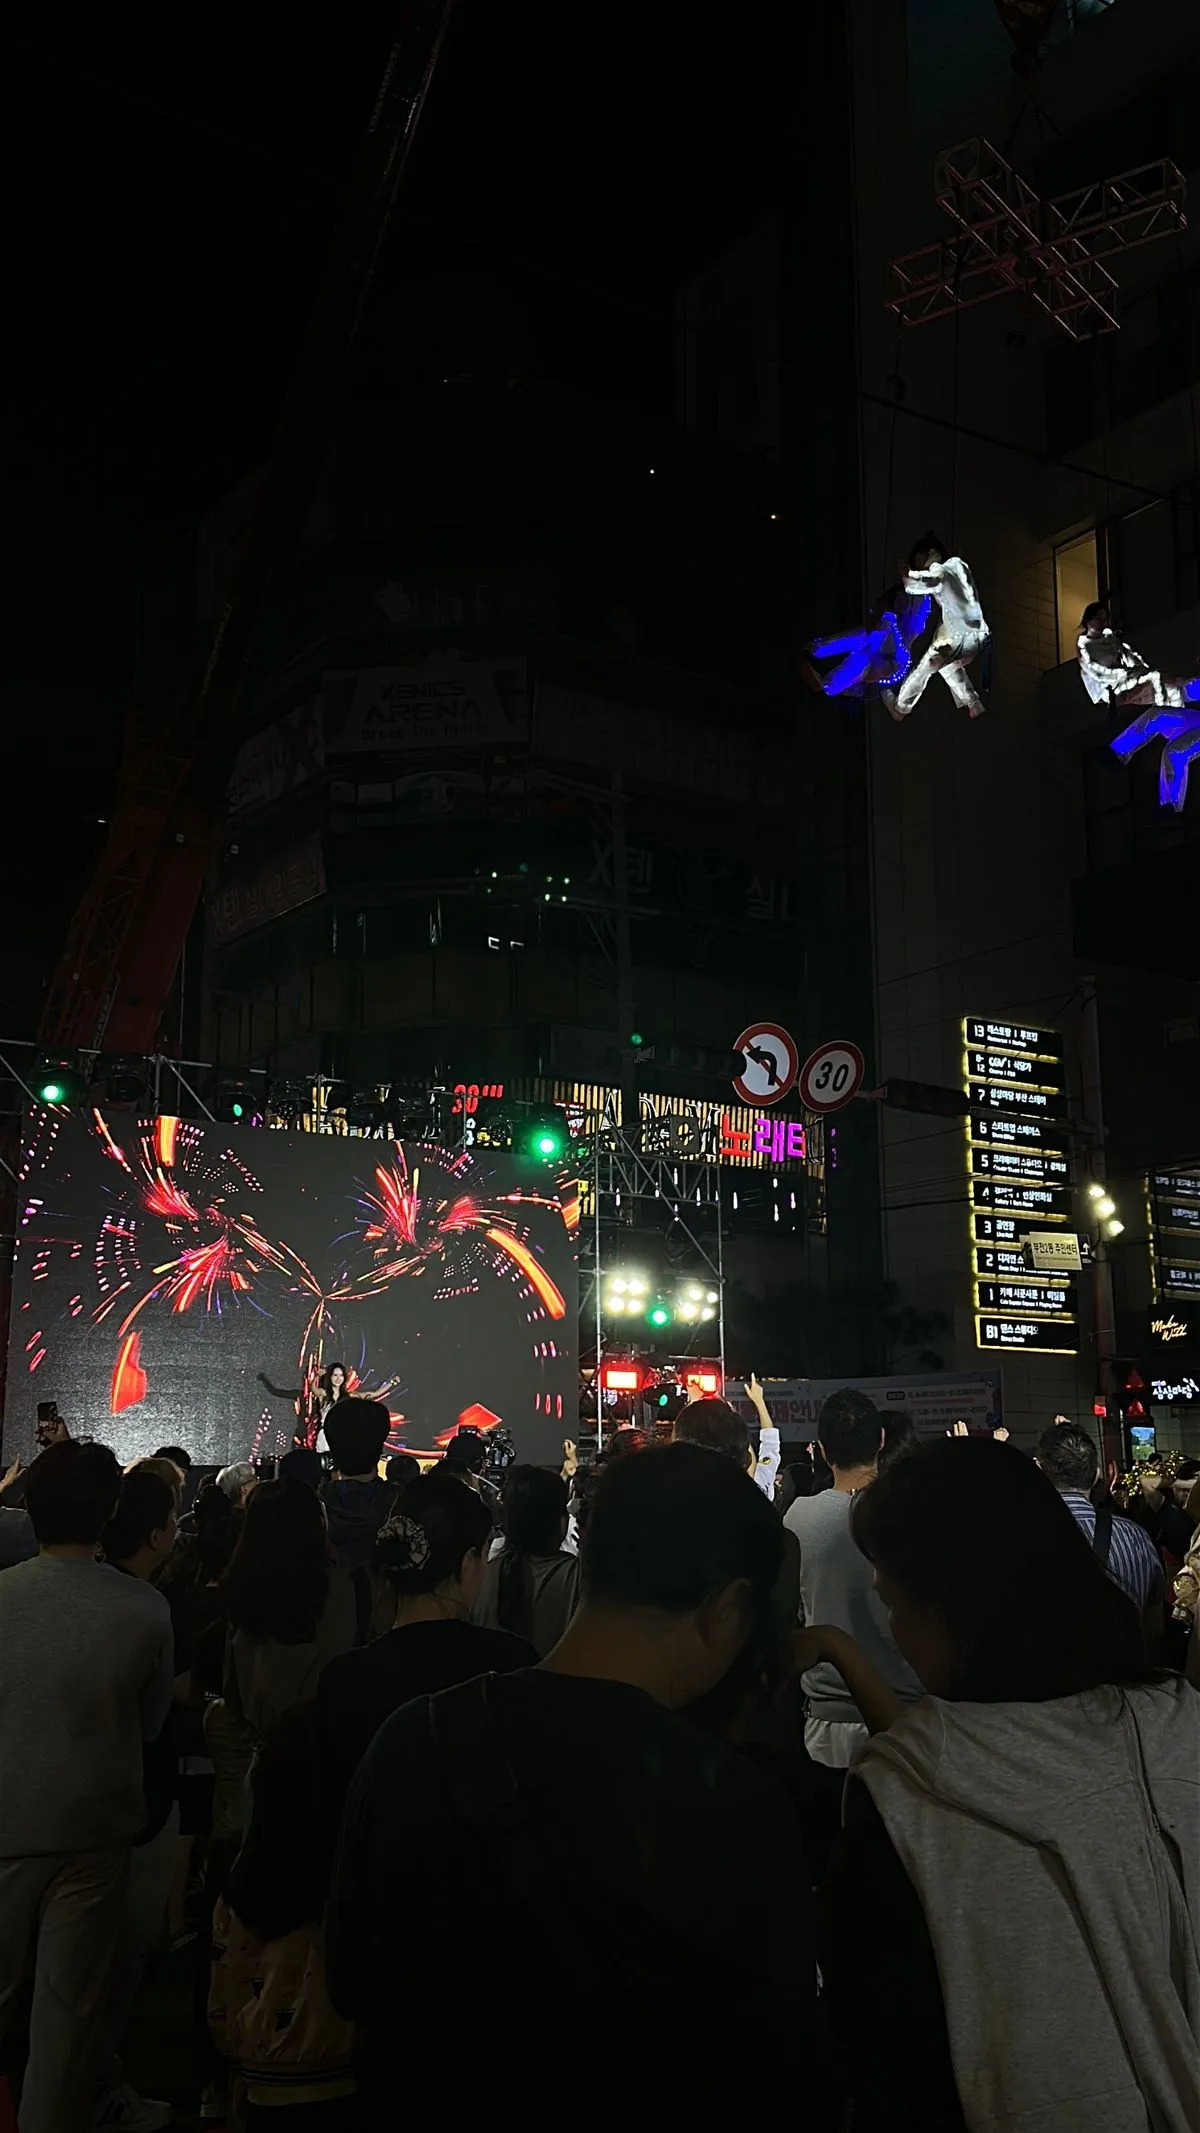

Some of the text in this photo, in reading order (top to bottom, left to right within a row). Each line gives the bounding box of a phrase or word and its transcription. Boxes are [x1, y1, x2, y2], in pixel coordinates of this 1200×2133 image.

[379, 679, 467, 701] XENICS
[364, 698, 482, 724] ARENA
[974, 1024, 985, 1037] 13
[815, 1060, 850, 1092] 30
[977, 1088, 986, 1101] 7
[1015, 1092, 1028, 1103] 부산
[979, 1121, 987, 1134] 6
[981, 1154, 989, 1167] 5
[984, 1220, 992, 1234] 3
[986, 1253, 994, 1267] 2
[997, 1252, 1017, 1265] 디자인
[1151, 1314, 1179, 1333] Make
[986, 1324, 999, 1339] B1
[1162, 1324, 1188, 1341] With
[1152, 1383, 1194, 1400] 상상마당
